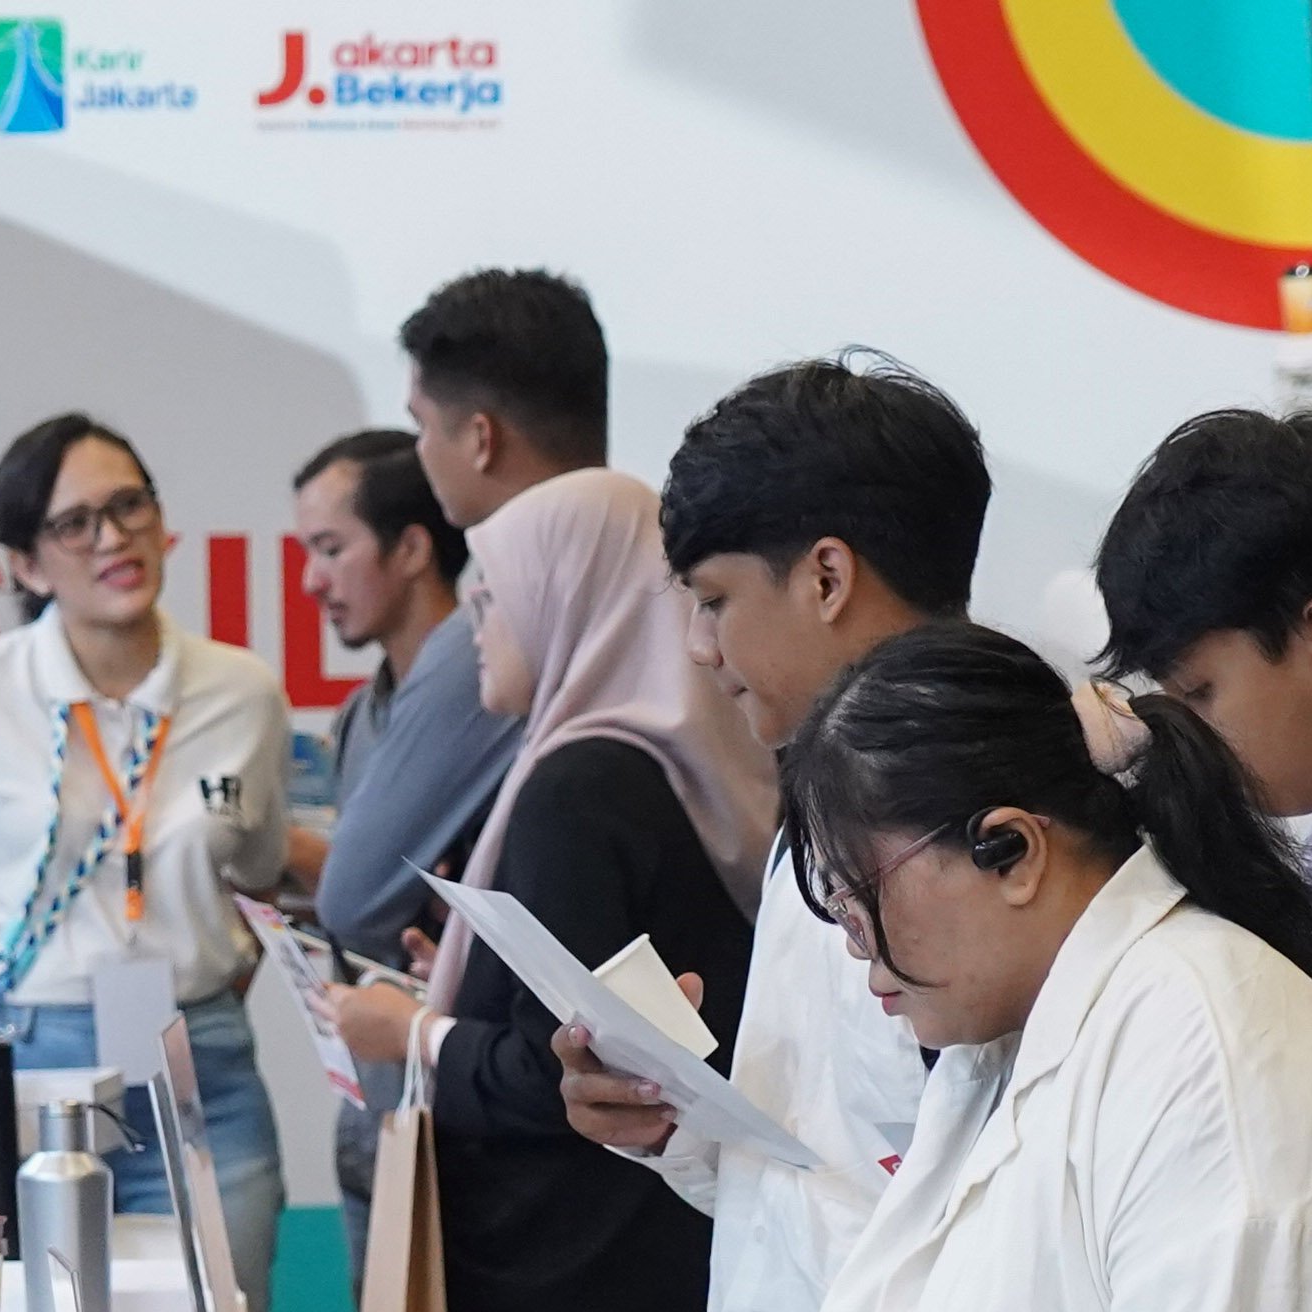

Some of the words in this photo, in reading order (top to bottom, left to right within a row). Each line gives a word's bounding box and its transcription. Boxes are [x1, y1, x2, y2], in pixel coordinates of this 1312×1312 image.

[75, 49, 143, 70] Karir
[76, 83, 197, 109] Jakarta
[335, 73, 500, 112] Bekerja
